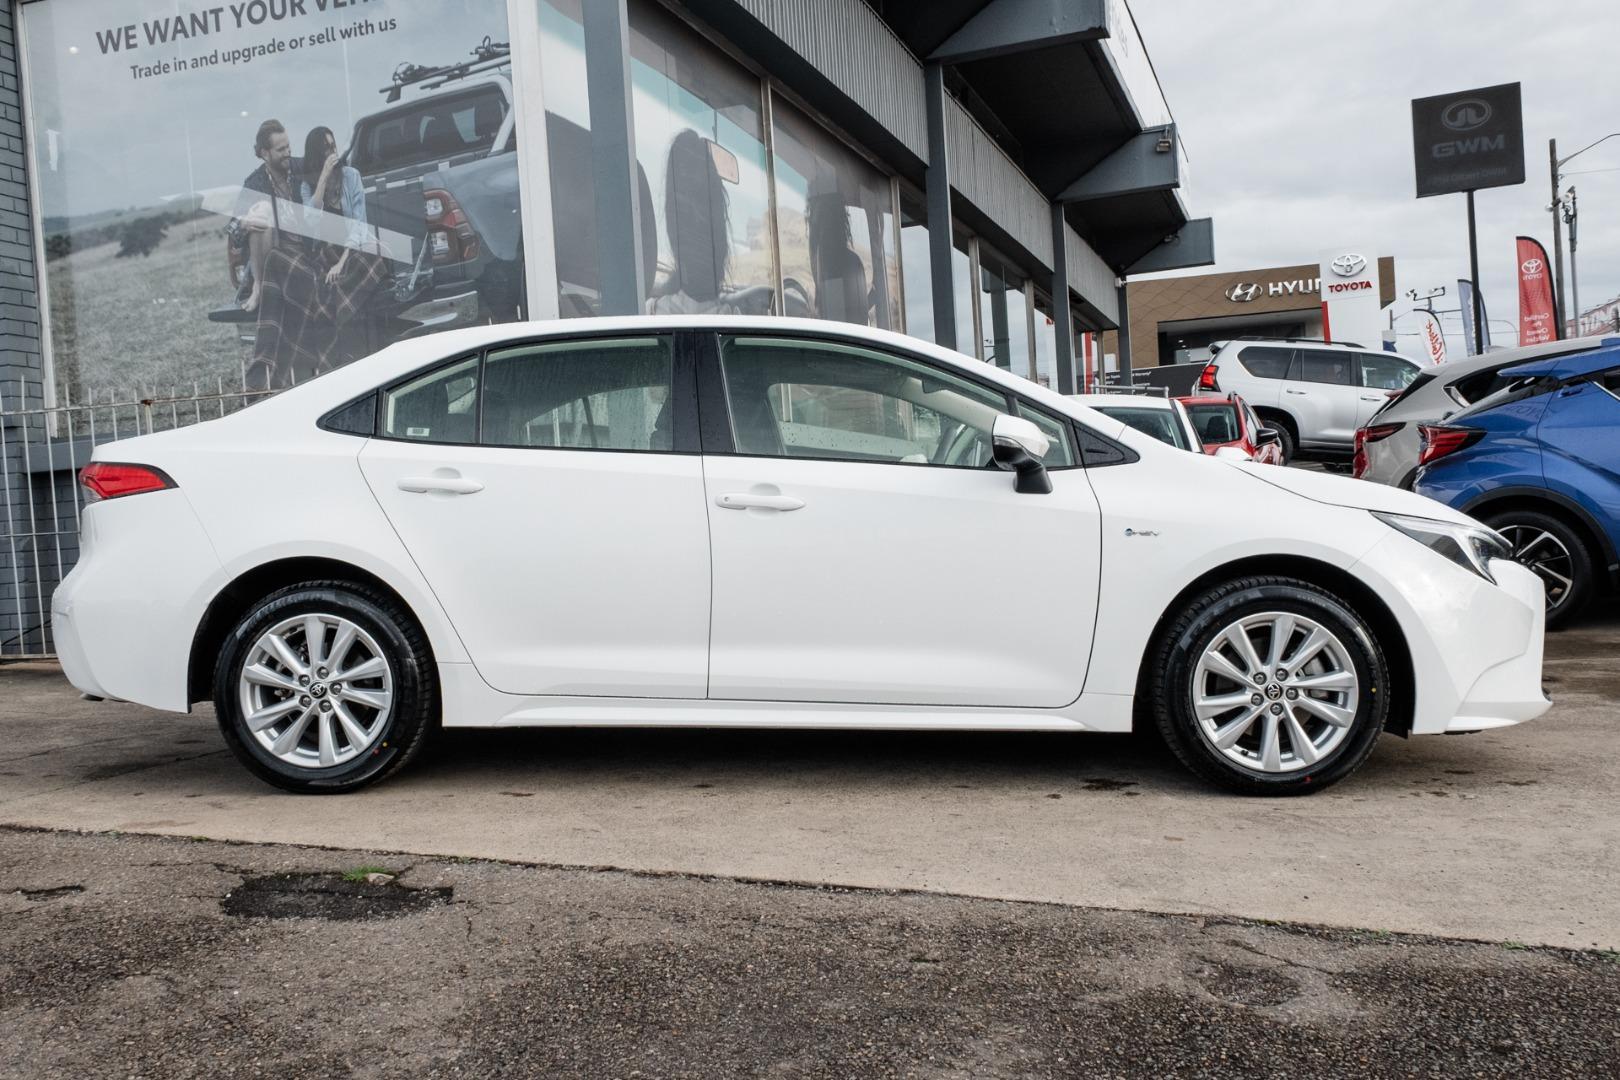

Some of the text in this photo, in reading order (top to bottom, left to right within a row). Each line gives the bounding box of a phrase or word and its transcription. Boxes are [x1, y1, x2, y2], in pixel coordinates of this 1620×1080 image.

[95, 0, 307, 54] WE WANT YOUR
[130, 18, 398, 79] Trade in and upgrade or sell with us
[1431, 134, 1505, 158] GWM
[1328, 281, 1372, 293] TOYOTA
